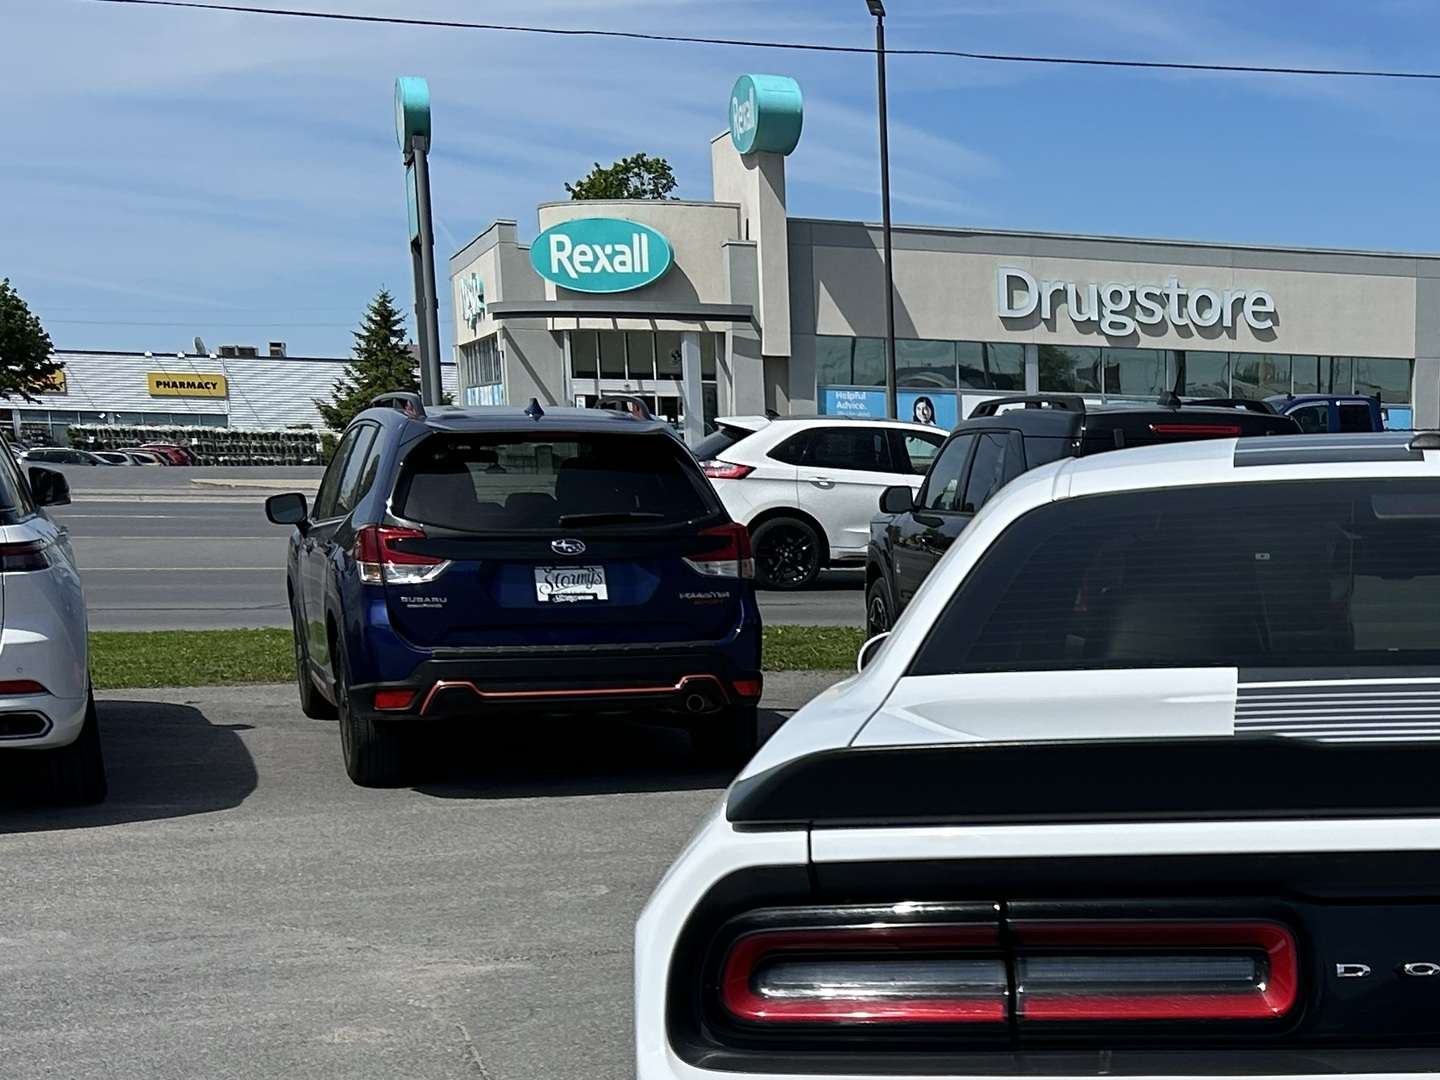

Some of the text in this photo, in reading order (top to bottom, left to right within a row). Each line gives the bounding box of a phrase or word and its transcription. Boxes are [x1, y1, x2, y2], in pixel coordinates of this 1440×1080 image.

[549, 232, 650, 279] Rexall
[998, 265, 1276, 337] Drugstore
[156, 380, 218, 390] PHARMACY
[835, 392, 867, 402] Helpful
[836, 400, 868, 410] Advice.
